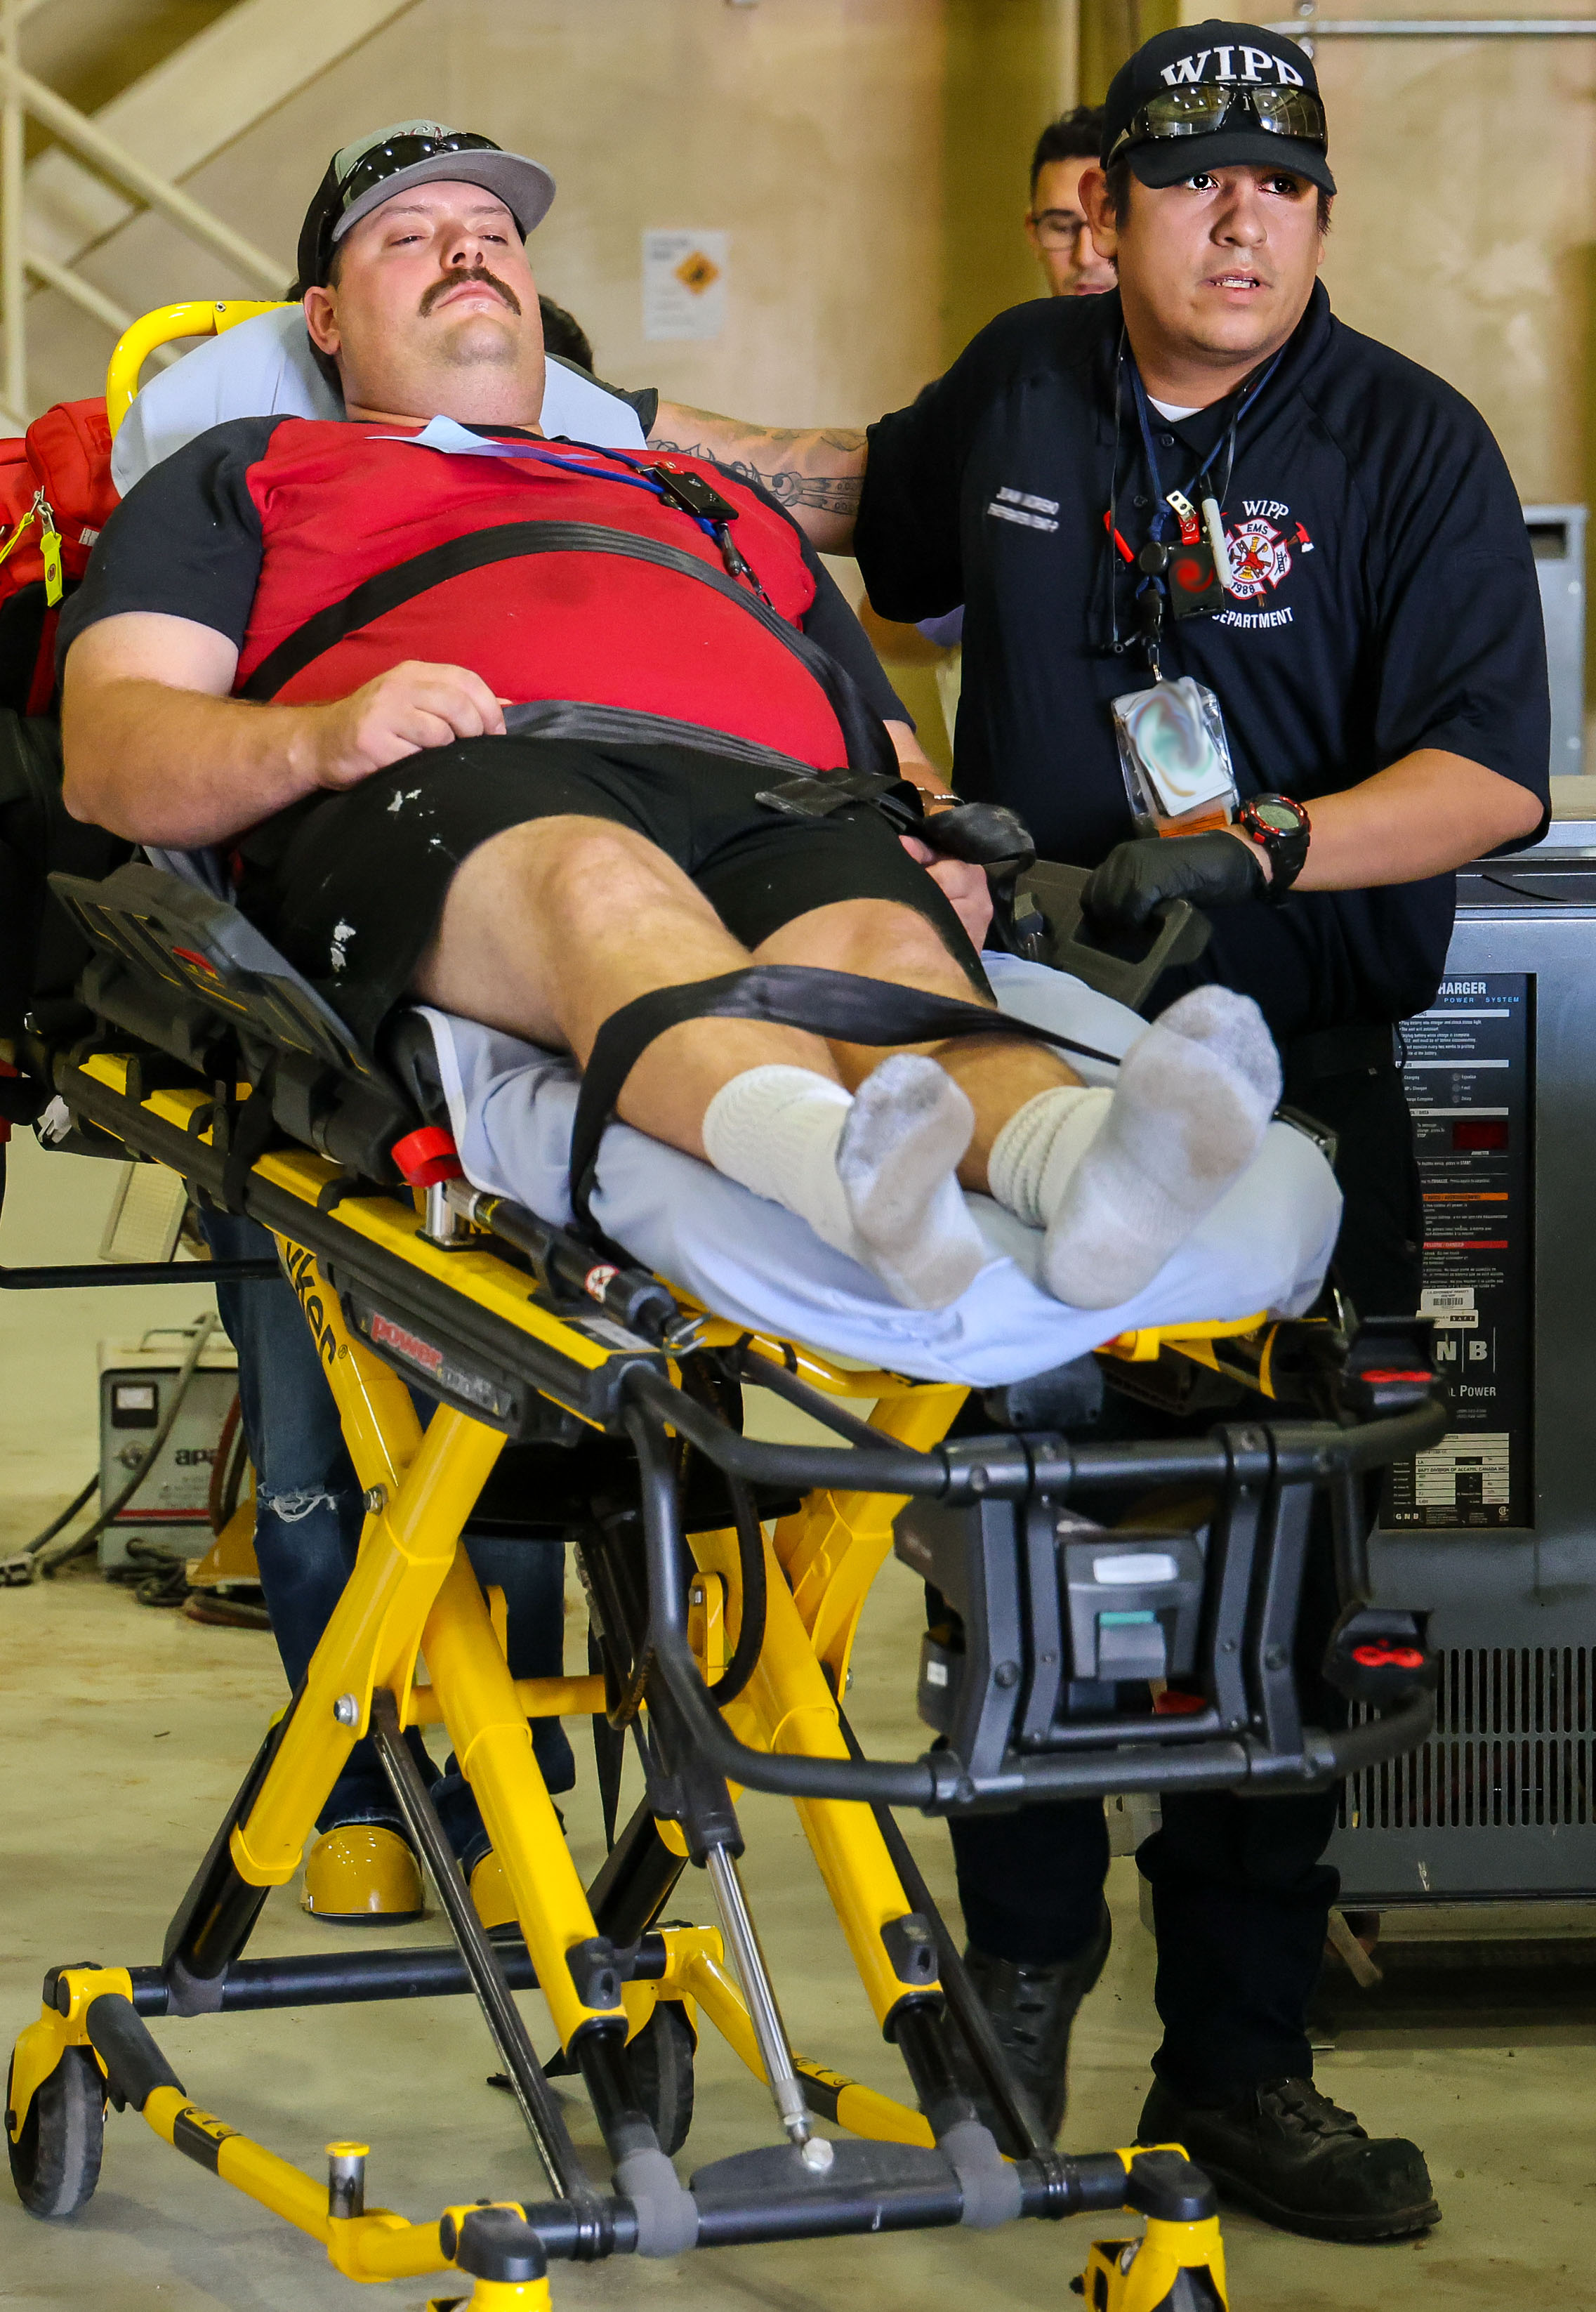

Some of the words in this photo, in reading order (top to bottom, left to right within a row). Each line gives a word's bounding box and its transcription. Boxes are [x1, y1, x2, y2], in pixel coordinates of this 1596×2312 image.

[1161, 45, 1304, 86] WIPP
[1242, 500, 1289, 520] WIPP
[1246, 523, 1269, 535] EMS
[1230, 582, 1255, 595] 1988
[1437, 982, 1487, 995] HARGER
[1460, 1385, 1496, 1397] POWER
